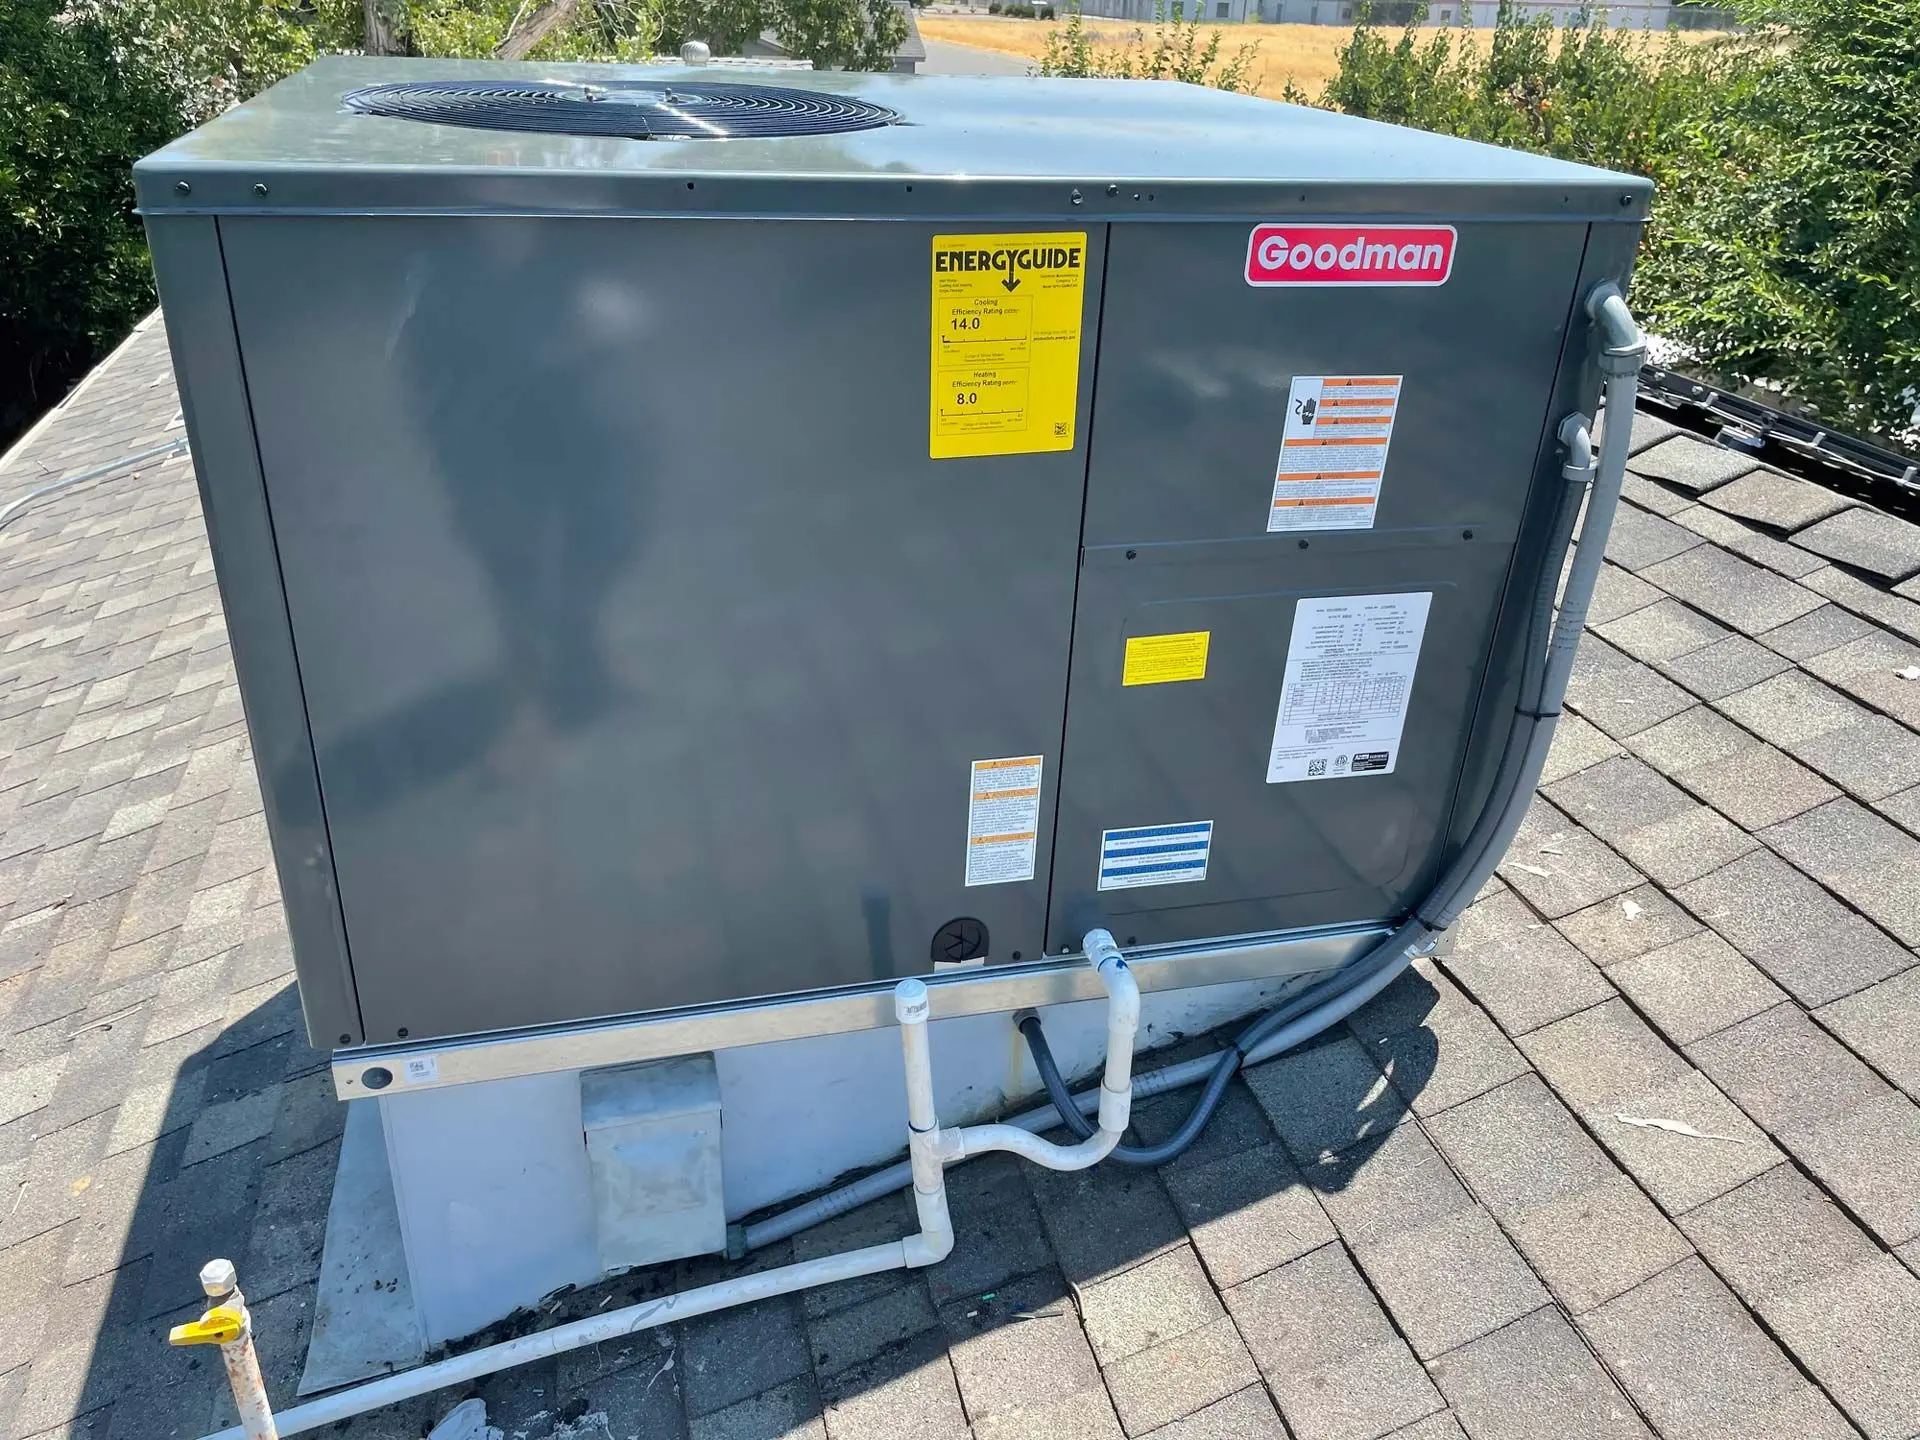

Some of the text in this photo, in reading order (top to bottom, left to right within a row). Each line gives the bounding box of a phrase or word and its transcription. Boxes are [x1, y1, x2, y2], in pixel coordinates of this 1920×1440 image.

[1258, 235, 1444, 270] Goodman
[935, 248, 1081, 272] ENERGYGUIDE
[952, 308, 981, 316] Efficiency
[983, 307, 1003, 315] Rating
[951, 318, 980, 330] 14.0
[973, 371, 997, 379] Heating
[982, 379, 1002, 387] Rating
[957, 393, 977, 404] 8.0
